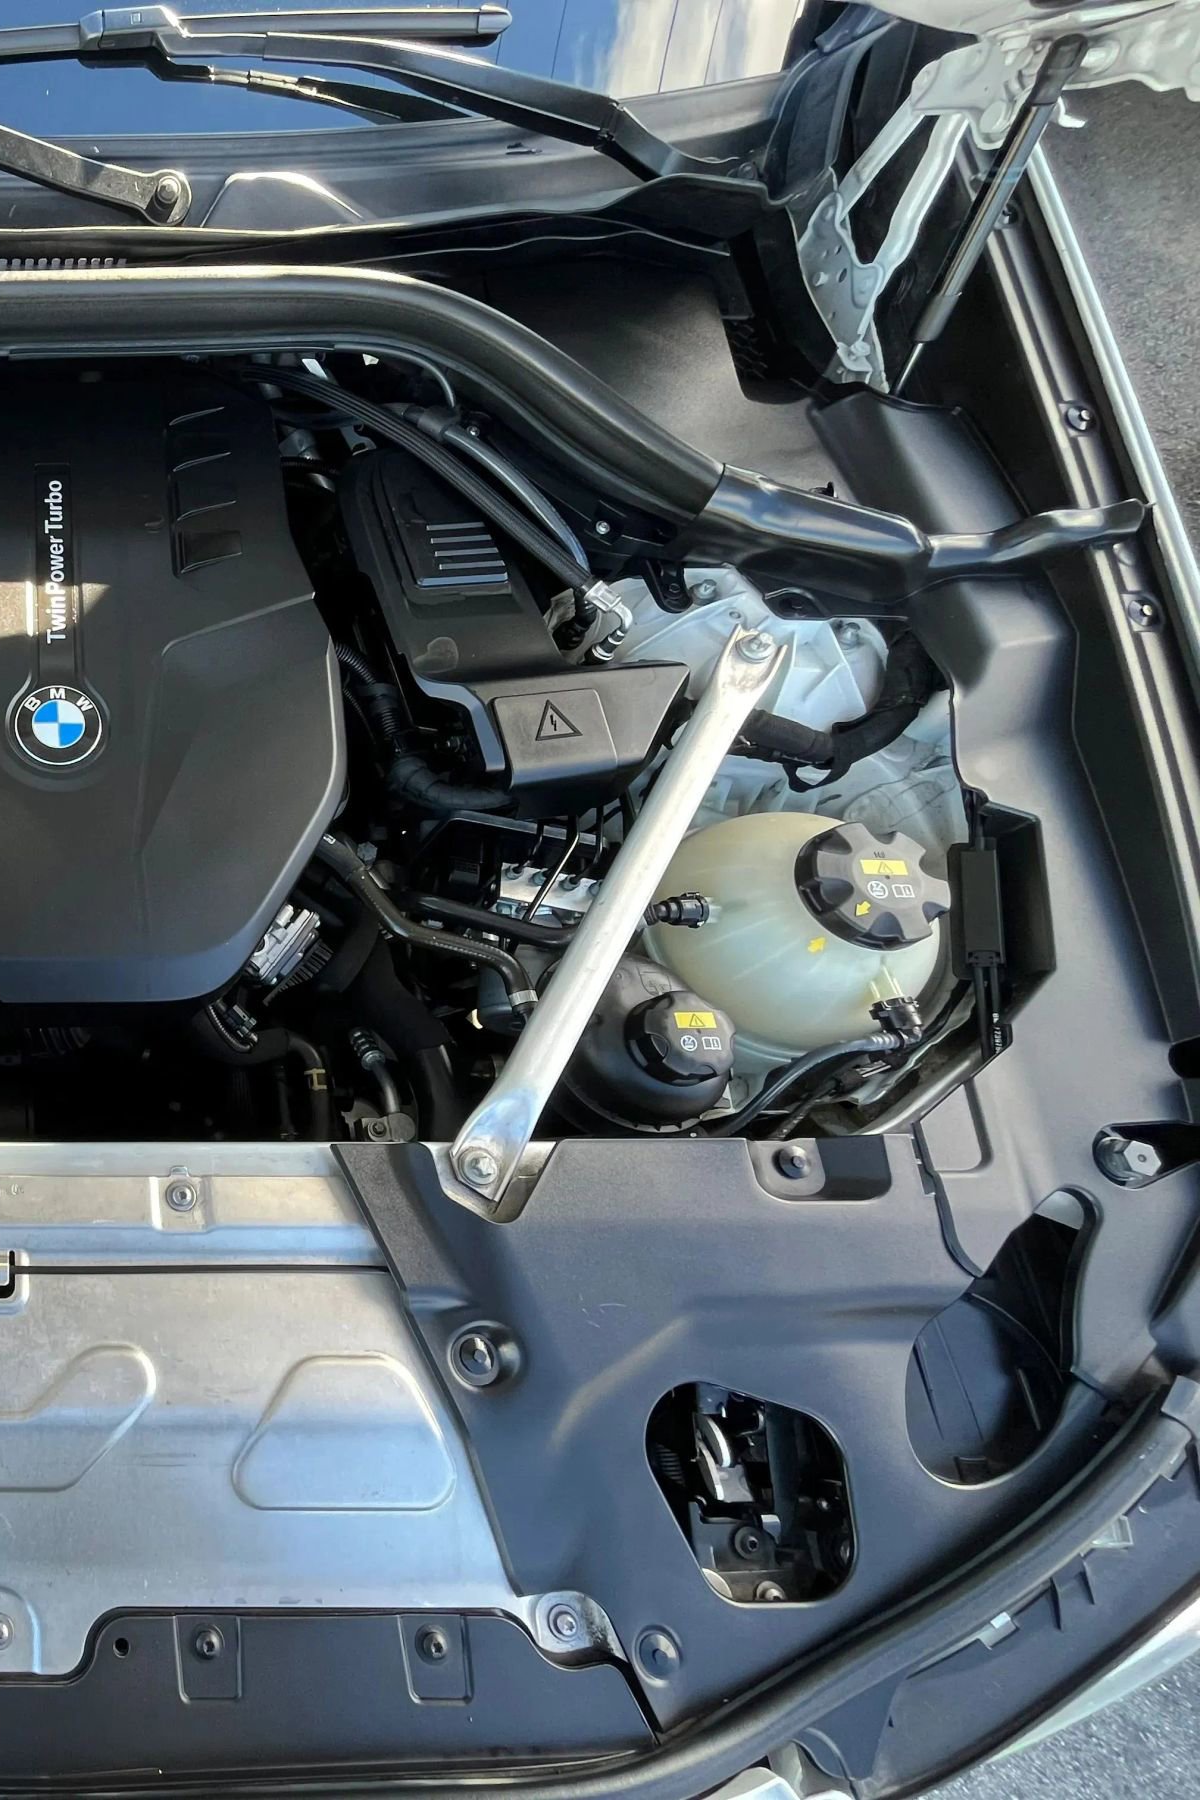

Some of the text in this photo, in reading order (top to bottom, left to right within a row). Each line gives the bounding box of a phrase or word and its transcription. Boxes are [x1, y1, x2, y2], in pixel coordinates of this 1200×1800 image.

[44, 480, 66, 644] TwinPower Turbo
[24, 688, 94, 712] BMW
